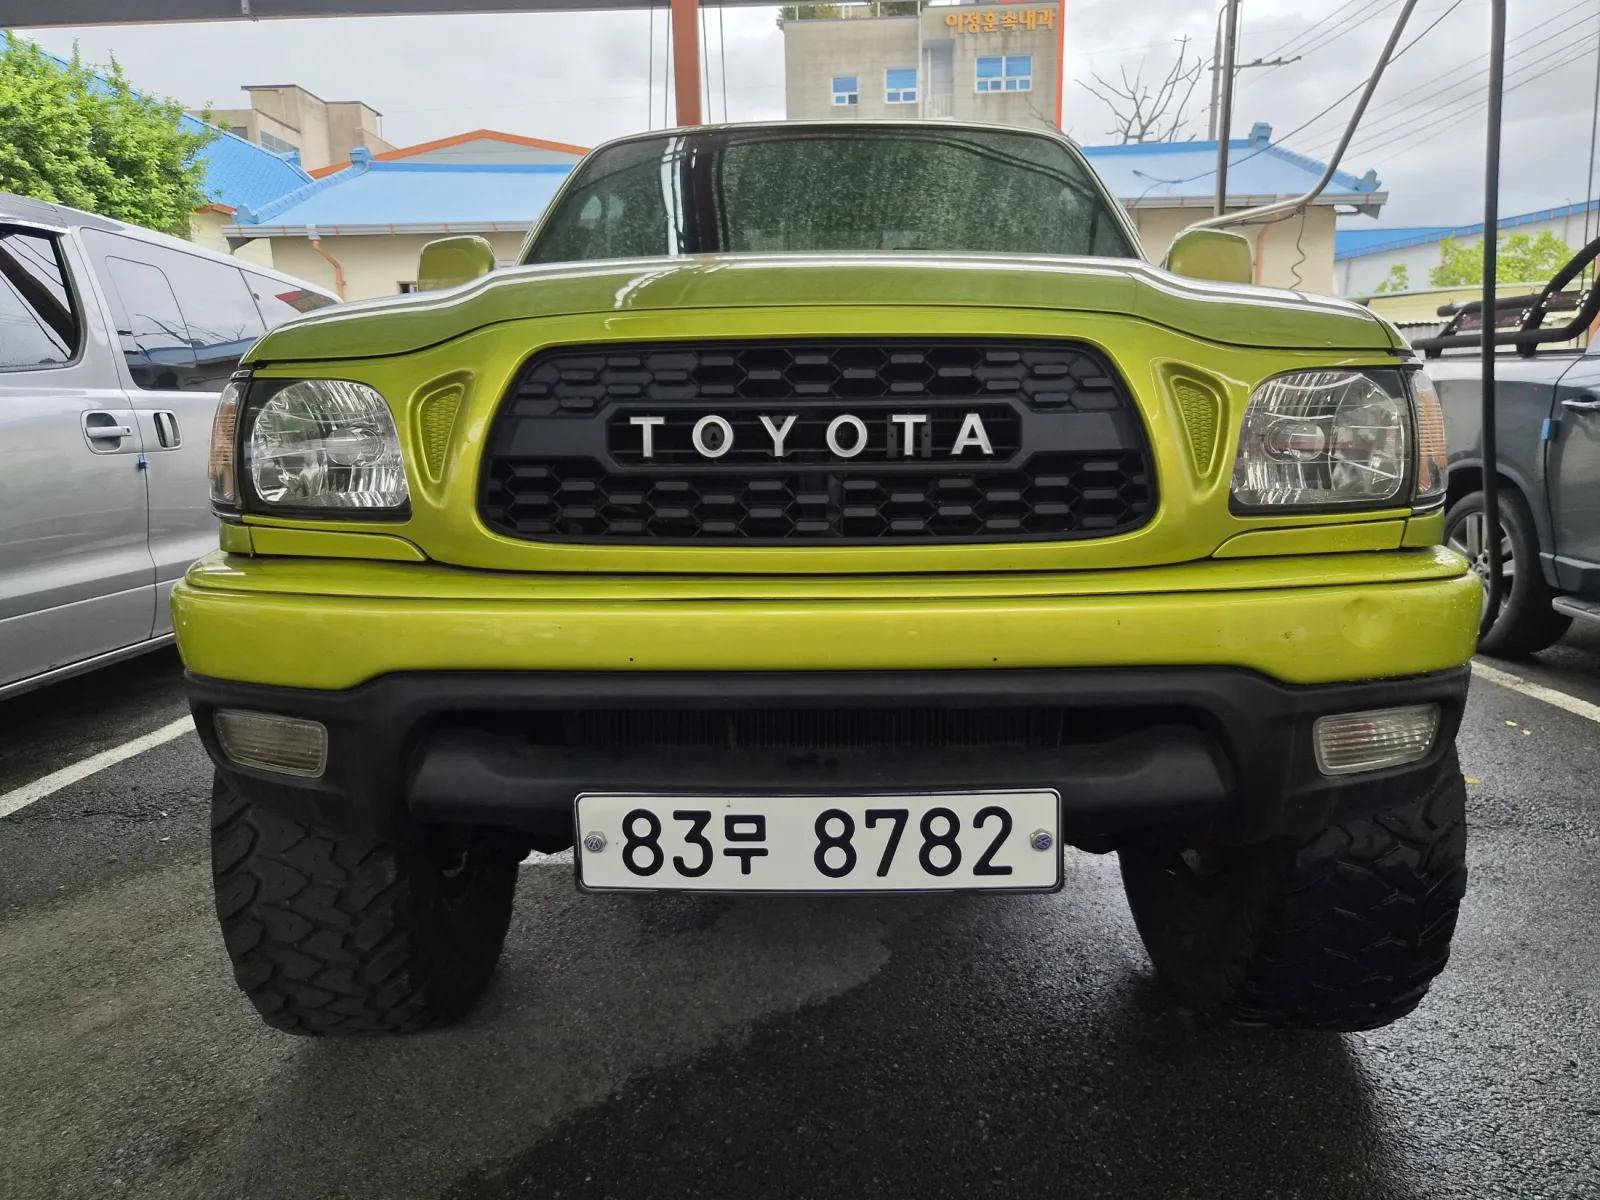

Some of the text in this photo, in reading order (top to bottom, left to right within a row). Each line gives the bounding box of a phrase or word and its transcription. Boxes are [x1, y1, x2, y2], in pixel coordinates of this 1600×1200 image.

[629, 413, 994, 458] TOYOTA
[621, 805, 1014, 878] 83무 8782
